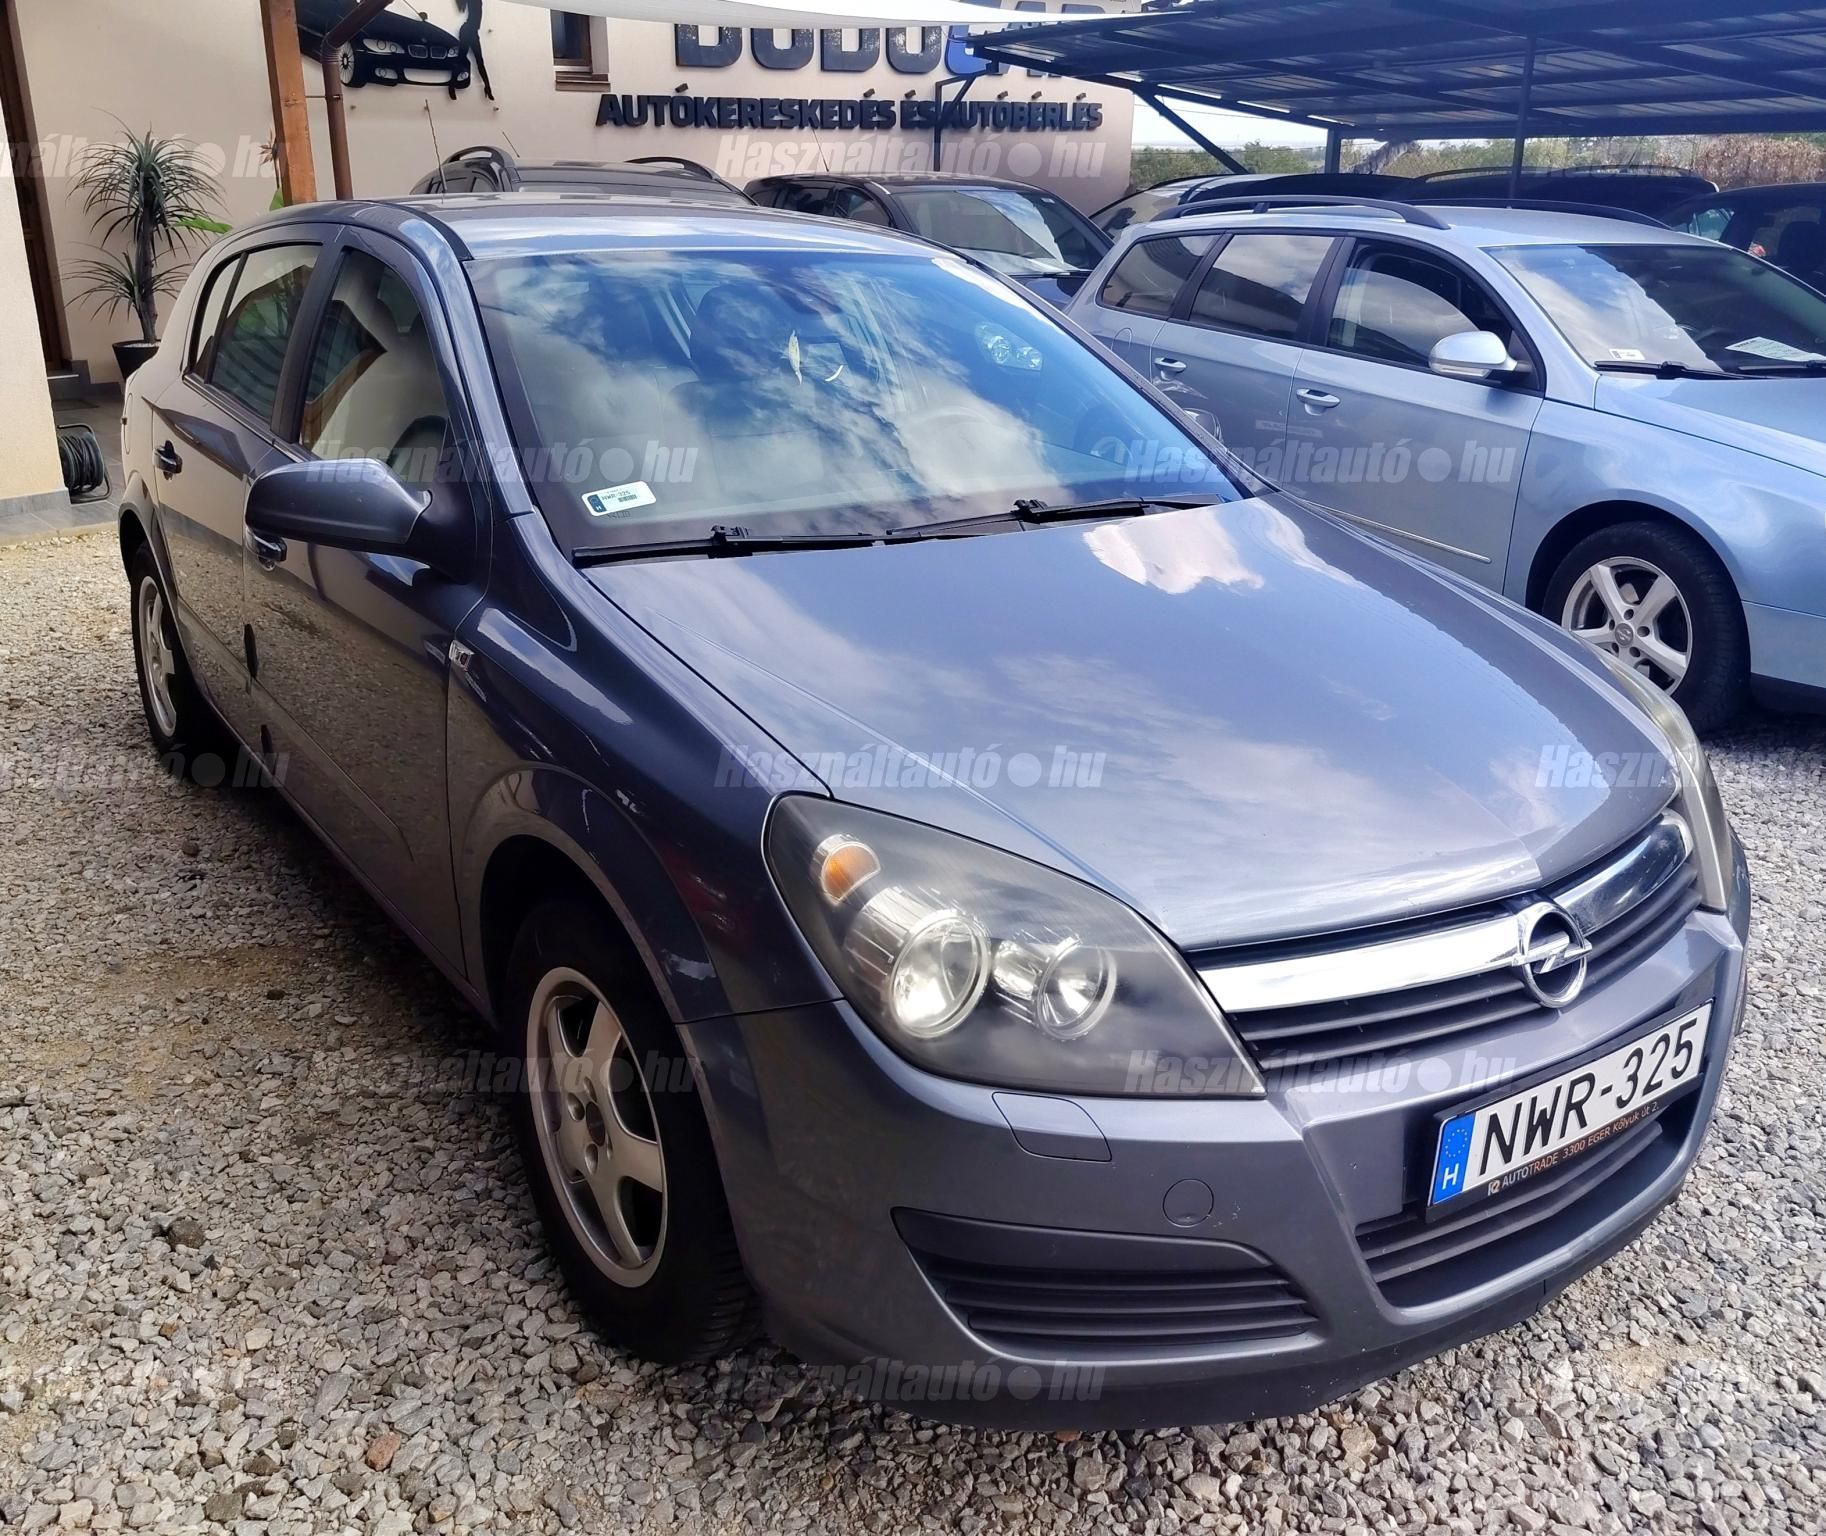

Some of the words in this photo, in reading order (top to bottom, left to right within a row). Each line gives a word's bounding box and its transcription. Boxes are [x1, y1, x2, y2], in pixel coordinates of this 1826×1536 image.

[595, 83, 896, 130] AUTÓKERESKEDÉS
[900, 90, 937, 129] ÉS
[940, 91, 1103, 131] AUTÓBÉRLÉS
[1478, 1016, 1698, 1176] NWR-325
[1441, 1162, 1461, 1191] H
[1501, 1153, 1560, 1189] AUTOTRADE
[1562, 1139, 1586, 1159] 3300
[1587, 1126, 1611, 1147] EGER
